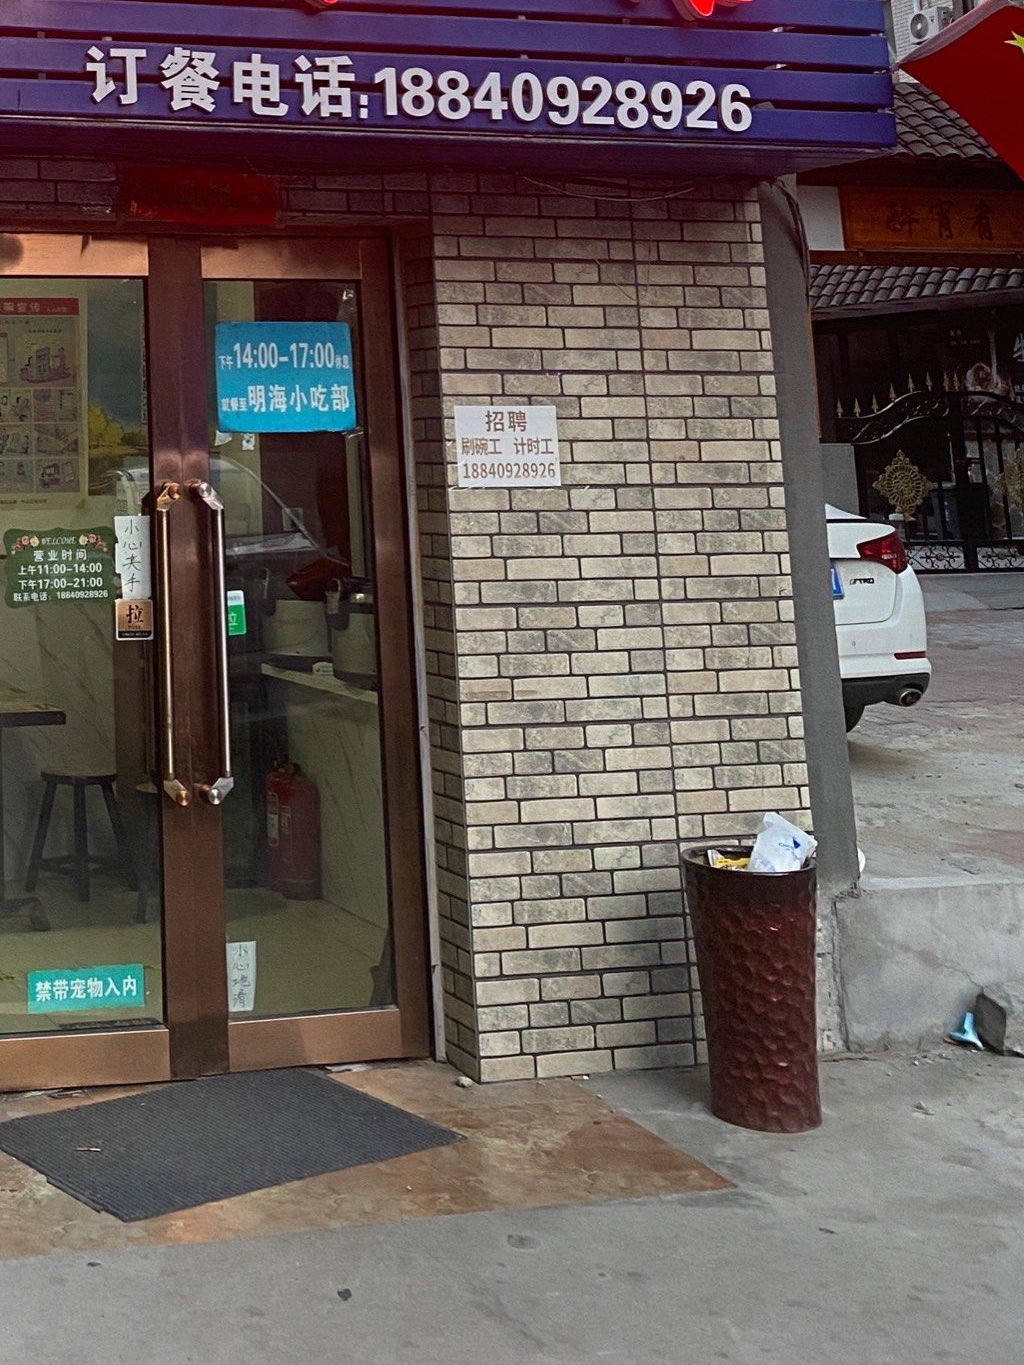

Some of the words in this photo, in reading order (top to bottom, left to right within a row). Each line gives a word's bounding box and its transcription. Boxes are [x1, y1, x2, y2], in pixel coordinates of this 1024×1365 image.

[220, 383, 350, 413] 就餐至明海小吃部
[484, 410, 528, 433] 招聘
[461, 437, 503, 456] 刷碗工
[513, 437, 555, 455] 计时工
[463, 462, 556, 479] 18840928926
[33, 549, 87, 562] 营业时间
[122, 519, 143, 593] 小心夹手
[126, 604, 144, 624] 拉
[232, 943, 252, 1008] 小心地滑
[35, 974, 138, 1003] 禁带宠物入内
